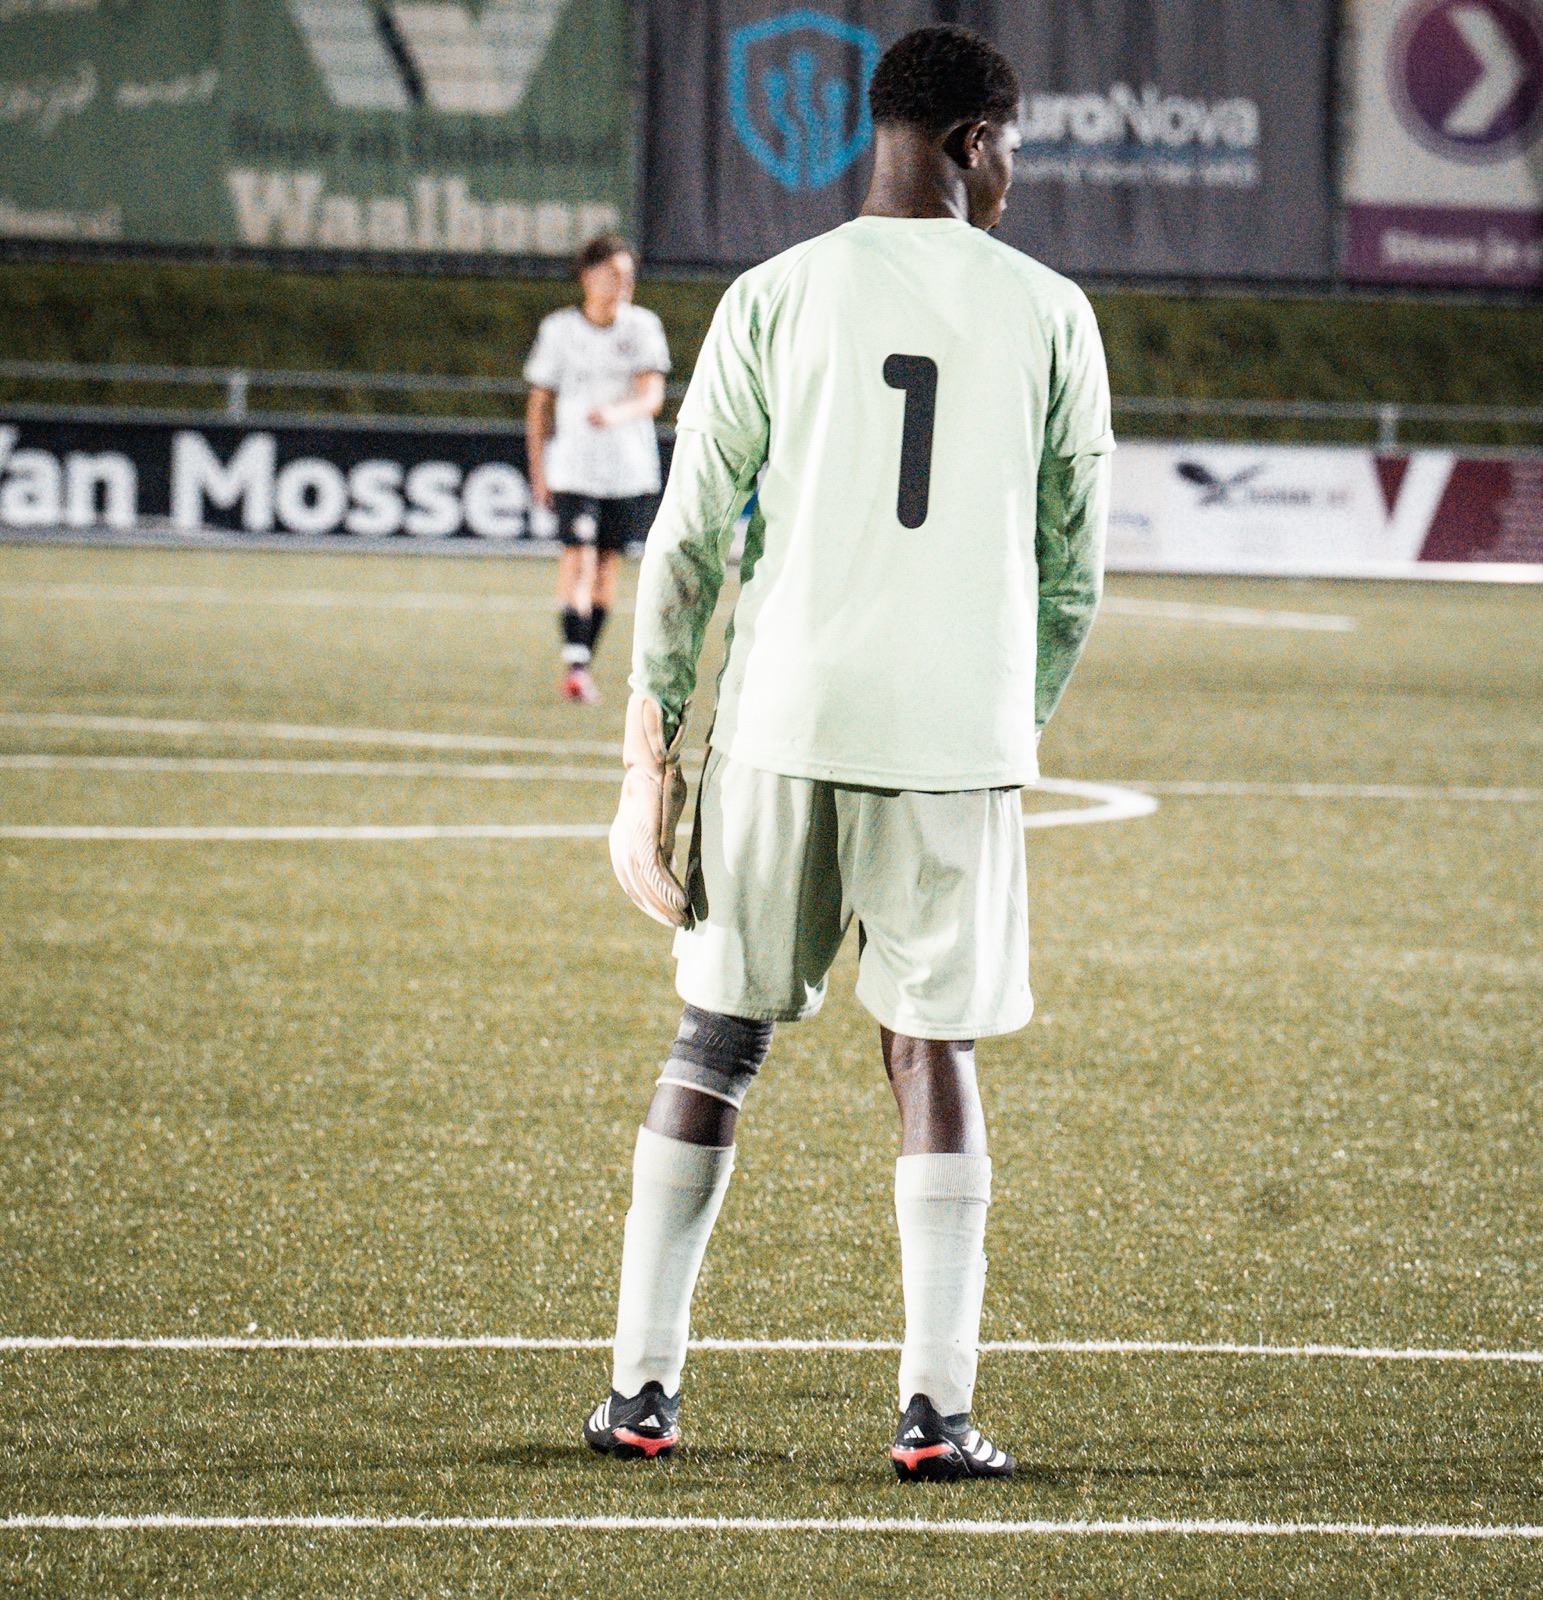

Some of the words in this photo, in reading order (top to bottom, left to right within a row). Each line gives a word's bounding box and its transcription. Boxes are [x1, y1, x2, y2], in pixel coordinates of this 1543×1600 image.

[1017, 82, 1260, 149] uroNova
[0, 424, 138, 529] an
[883, 353, 938, 529] 1
